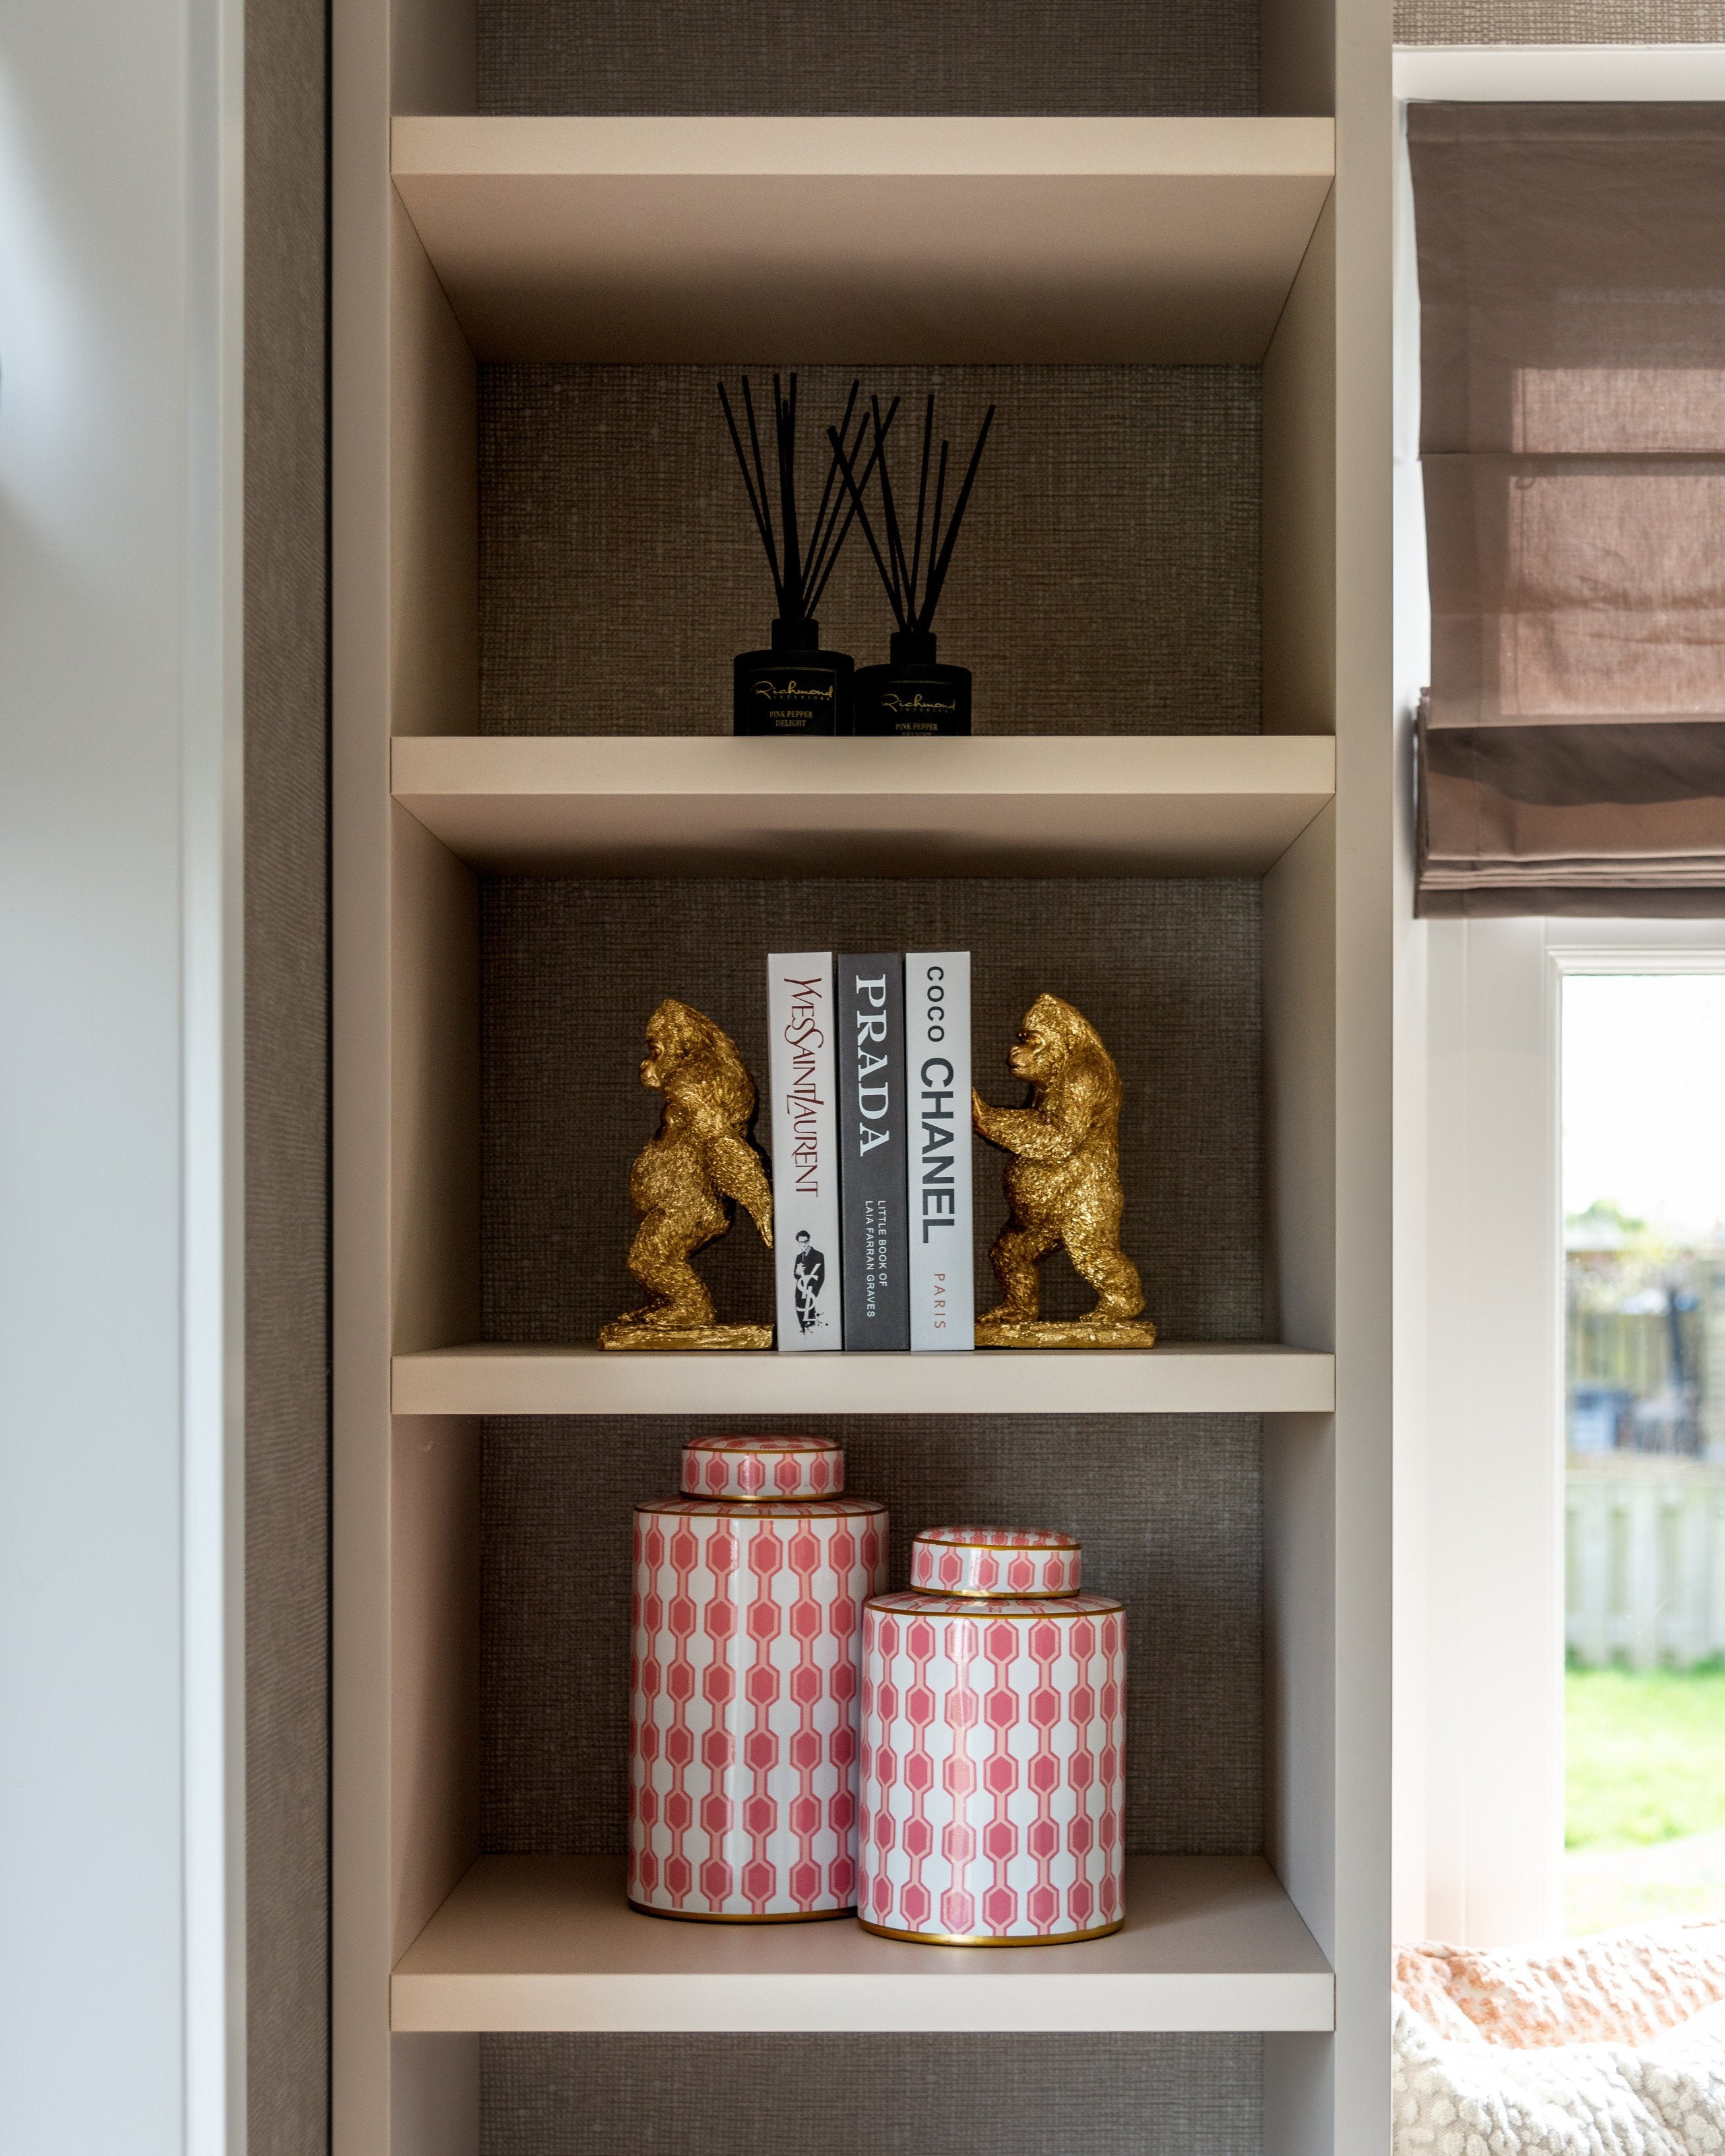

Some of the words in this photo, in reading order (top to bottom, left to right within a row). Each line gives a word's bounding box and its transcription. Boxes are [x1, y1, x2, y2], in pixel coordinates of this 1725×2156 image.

[751, 680, 833, 699] Richmond
[879, 694, 956, 712] Richmond
[927, 965, 945, 1042] COCO
[856, 974, 890, 1157] PRADA
[920, 1057, 955, 1244] CHANEL
[865, 1200, 874, 1224] LAIA
[877, 1200, 887, 1236] LITTLE
[865, 1228, 875, 1271] FARRAN
[878, 1239, 887, 1269] BOOK
[867, 1274, 875, 1318] GRAVES
[879, 1273, 887, 1287] OF
[933, 1273, 946, 1329] PARIS
